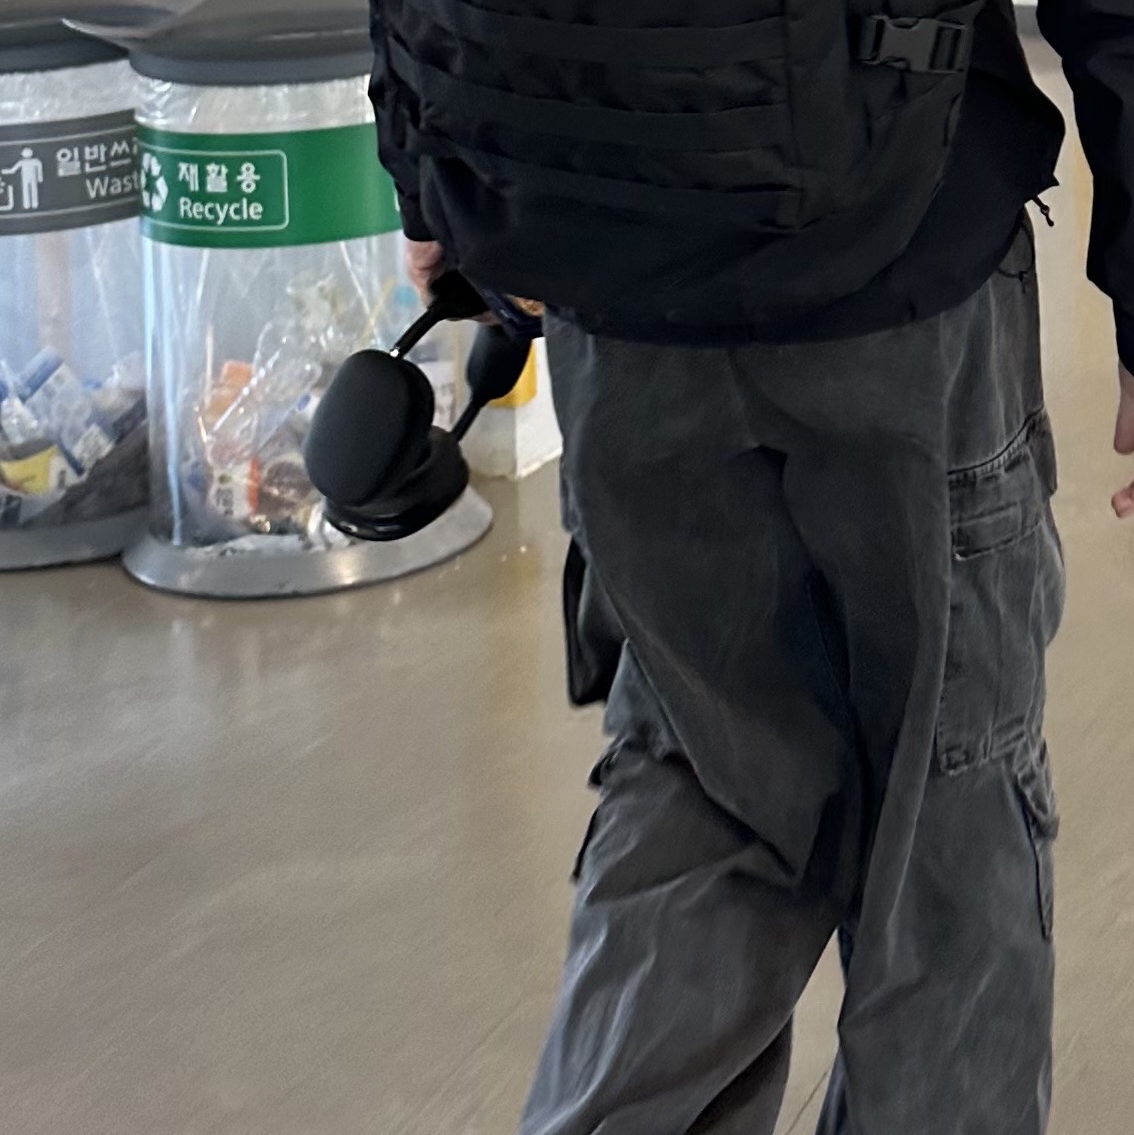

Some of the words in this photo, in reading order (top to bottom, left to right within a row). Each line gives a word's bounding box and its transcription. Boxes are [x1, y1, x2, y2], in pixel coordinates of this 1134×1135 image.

[56, 140, 138, 178] 일반쓰
[85, 169, 139, 199] Wast
[179, 196, 264, 226] Recycle
